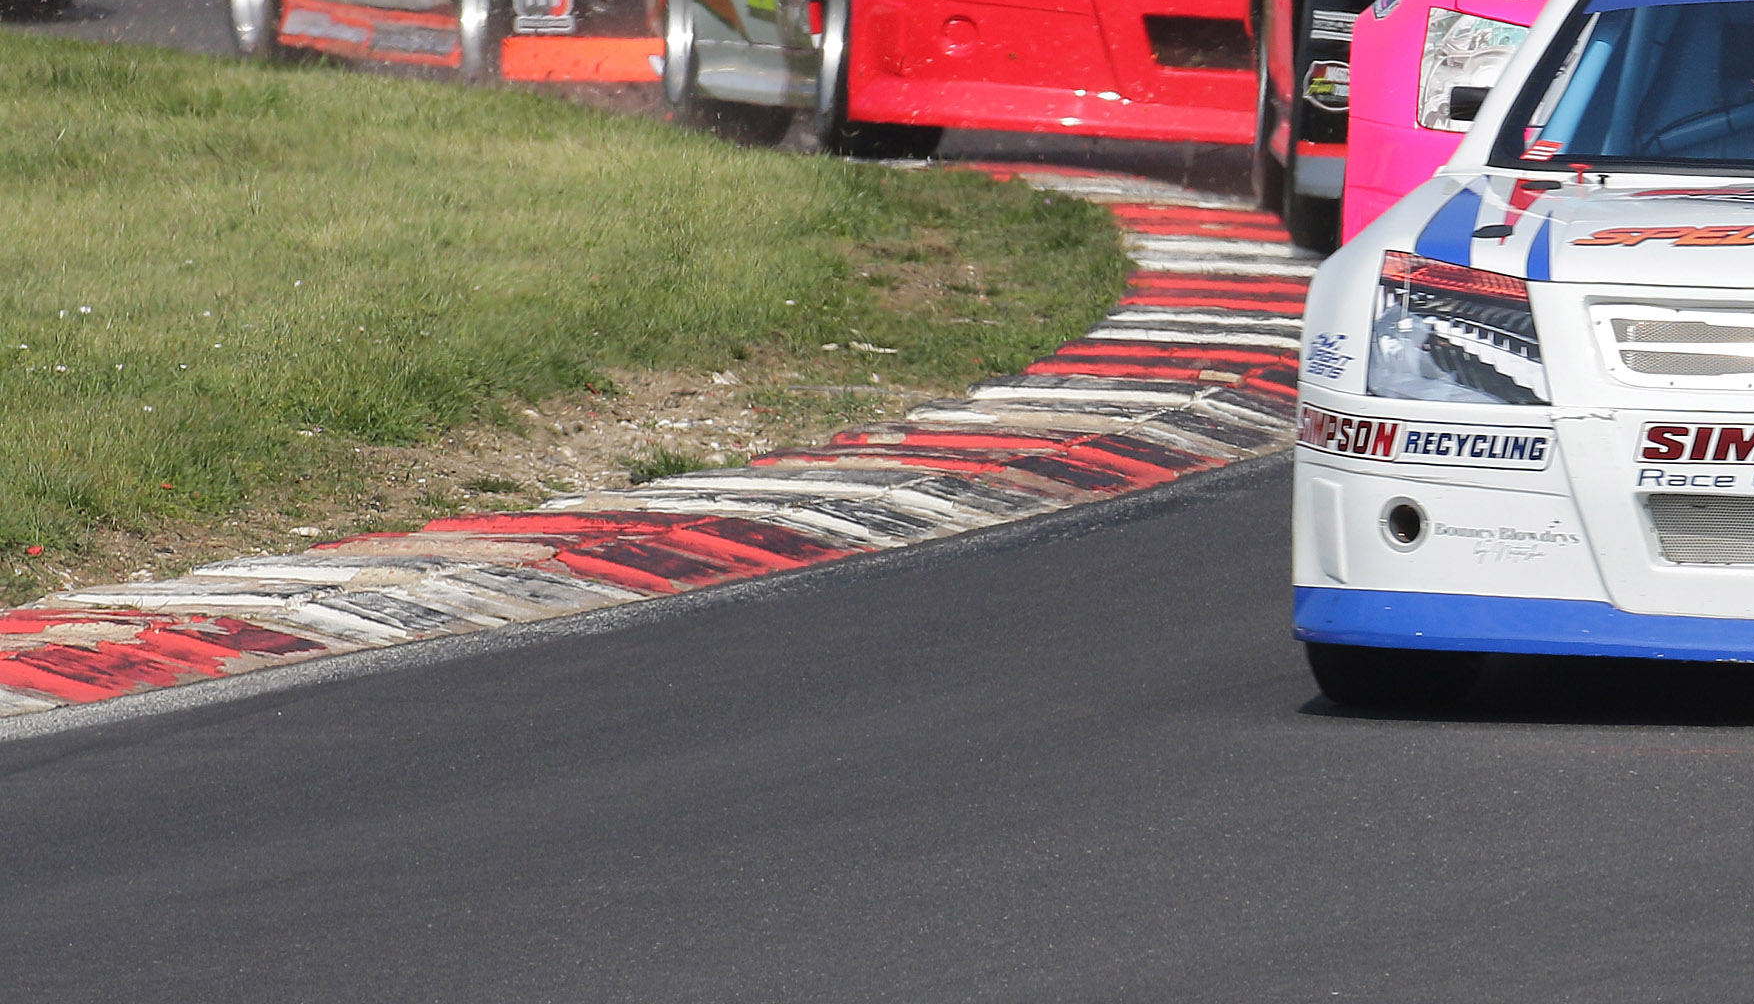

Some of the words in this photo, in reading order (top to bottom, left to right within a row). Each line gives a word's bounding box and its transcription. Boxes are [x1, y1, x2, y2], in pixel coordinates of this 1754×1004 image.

[1299, 405, 1399, 457] SIMPSON
[1403, 430, 1547, 461] RECYCLING
[1636, 469, 1737, 490] Race
